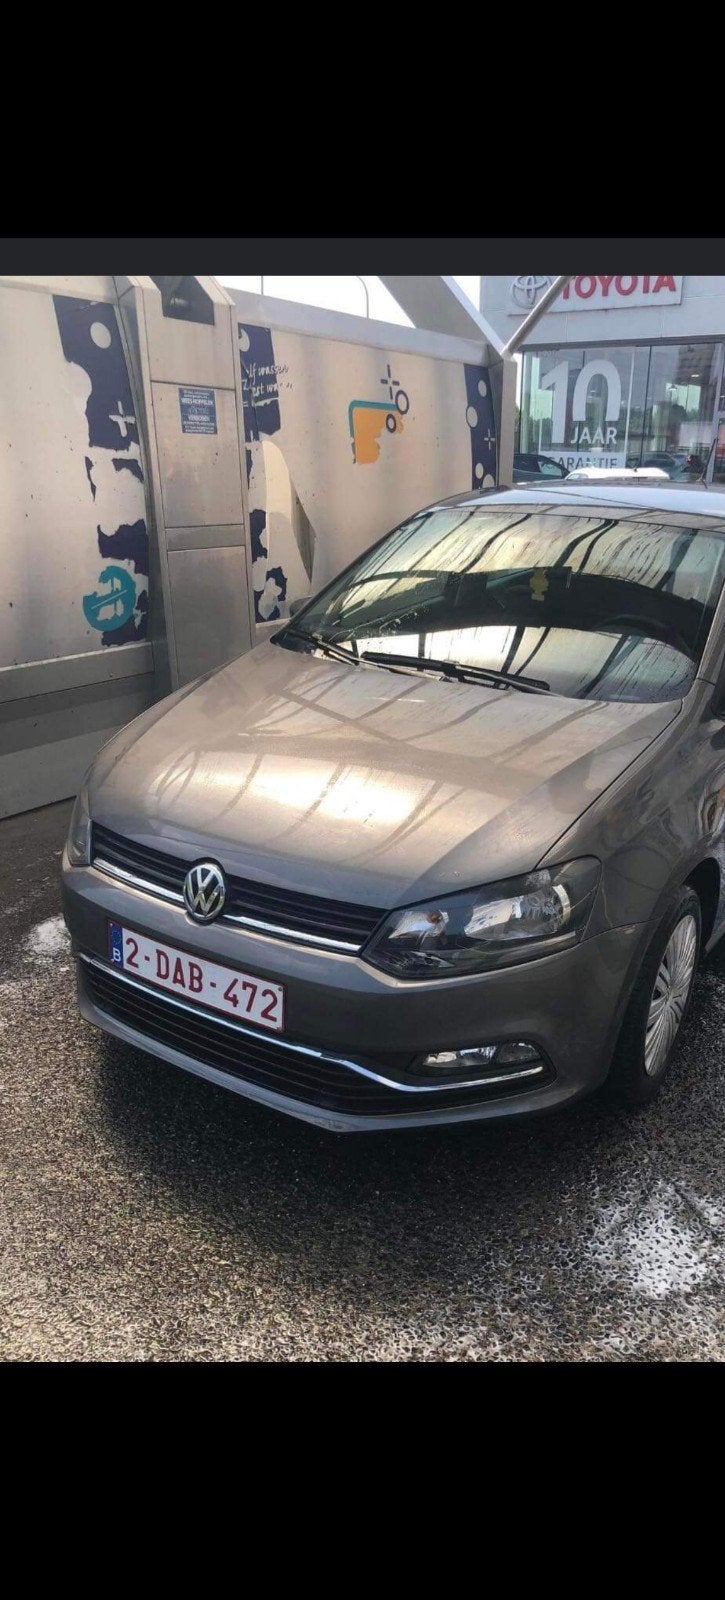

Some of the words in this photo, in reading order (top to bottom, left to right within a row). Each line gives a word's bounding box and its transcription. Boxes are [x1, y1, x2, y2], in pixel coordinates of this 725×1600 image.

[541, 358, 622, 444] 10
[570, 426, 618, 445] JAAR
[548, 456, 618, 470] ARANTIE
[112, 947, 122, 962] B
[125, 937, 278, 1023] 2-DAB-472
